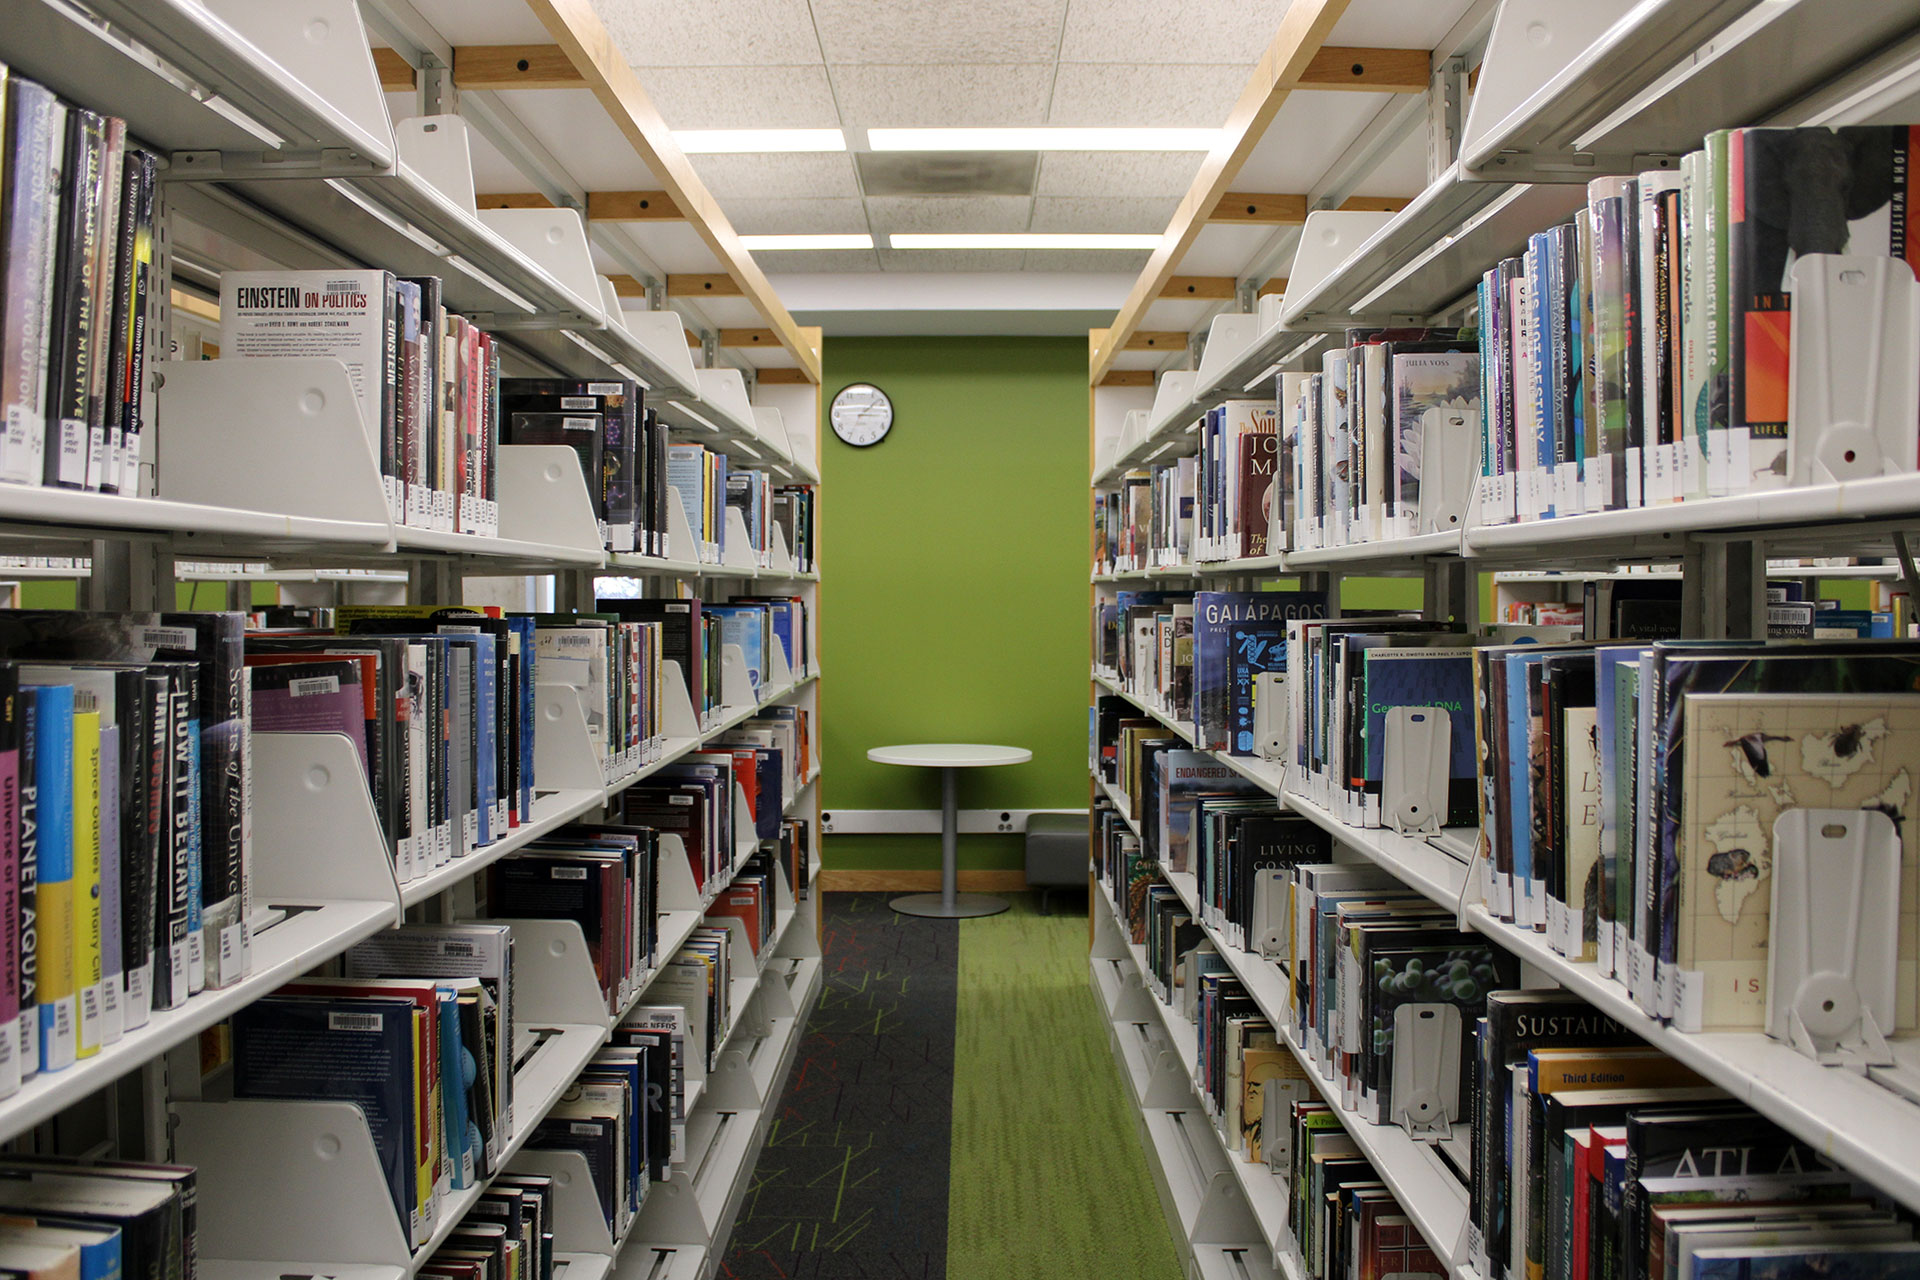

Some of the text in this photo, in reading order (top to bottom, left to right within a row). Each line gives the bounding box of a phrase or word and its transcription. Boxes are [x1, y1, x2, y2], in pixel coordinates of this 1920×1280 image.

[31, 104, 46, 202] CHAISSON
[1893, 149, 1905, 184] JOHN
[1683, 176, 1692, 220] How
[79, 149, 100, 331] THE ALLURE OF THE
[121, 171, 139, 343] A BRIEFER HISTORY OF TIME
[25, 268, 36, 290] OF
[237, 287, 367, 309] EINSTEIN ON POLITICS
[1683, 263, 1693, 324] Works
[1706, 205, 1718, 367] THE SERENGETI RULES
[1753, 295, 1772, 309] IN
[135, 316, 145, 352] Ultimate
[1530, 247, 1545, 443] DNA IS NOT DESTINY
[1660, 314, 1668, 343] with
[386, 319, 396, 386] EINSTEIN
[1406, 359, 1450, 368] JULIA VOSS
[1552, 289, 1562, 421] DRAWING MAP
[131, 354, 142, 406] Explanations
[407, 355, 416, 409] WALTER
[129, 418, 138, 432] the
[130, 407, 139, 417] of
[1754, 424, 1783, 436] LIFE,
[1249, 546, 1262, 556] of
[1250, 533, 1267, 545] The
[1206, 598, 1324, 625] GALÁPAGOS
[1629, 623, 1677, 633] A vital new
[1784, 624, 1809, 638] vivid,
[133, 698, 142, 751] BRIAN
[1435, 701, 1463, 712] DNA
[175, 702, 189, 760] HOW
[224, 668, 243, 817] Secrets of the
[91, 748, 100, 800] Space
[148, 692, 169, 835] DARK COSMOS
[187, 756, 196, 796] Cosmology
[403, 730, 411, 830] OPPENHEIMER
[1176, 767, 1227, 779] ENDANGERED
[1552, 745, 1560, 847] ECOLOGICAL
[1646, 670, 1660, 911] Climate Change and Biodiversity
[4, 777, 16, 860] Universe
[188, 798, 197, 832] Explains
[20, 787, 37, 895] PLANET
[174, 812, 189, 901] BEGAN
[1260, 844, 1317, 856] LIVING
[3, 890, 17, 996] Multiverse?
[91, 906, 100, 949] Harry
[20, 908, 37, 1001] AQUA
[1734, 979, 1759, 993] IS
[650, 1022, 677, 1031] NEEDS
[1563, 1072, 1625, 1084] Third Edition
[1313, 1118, 1320, 1127] A
